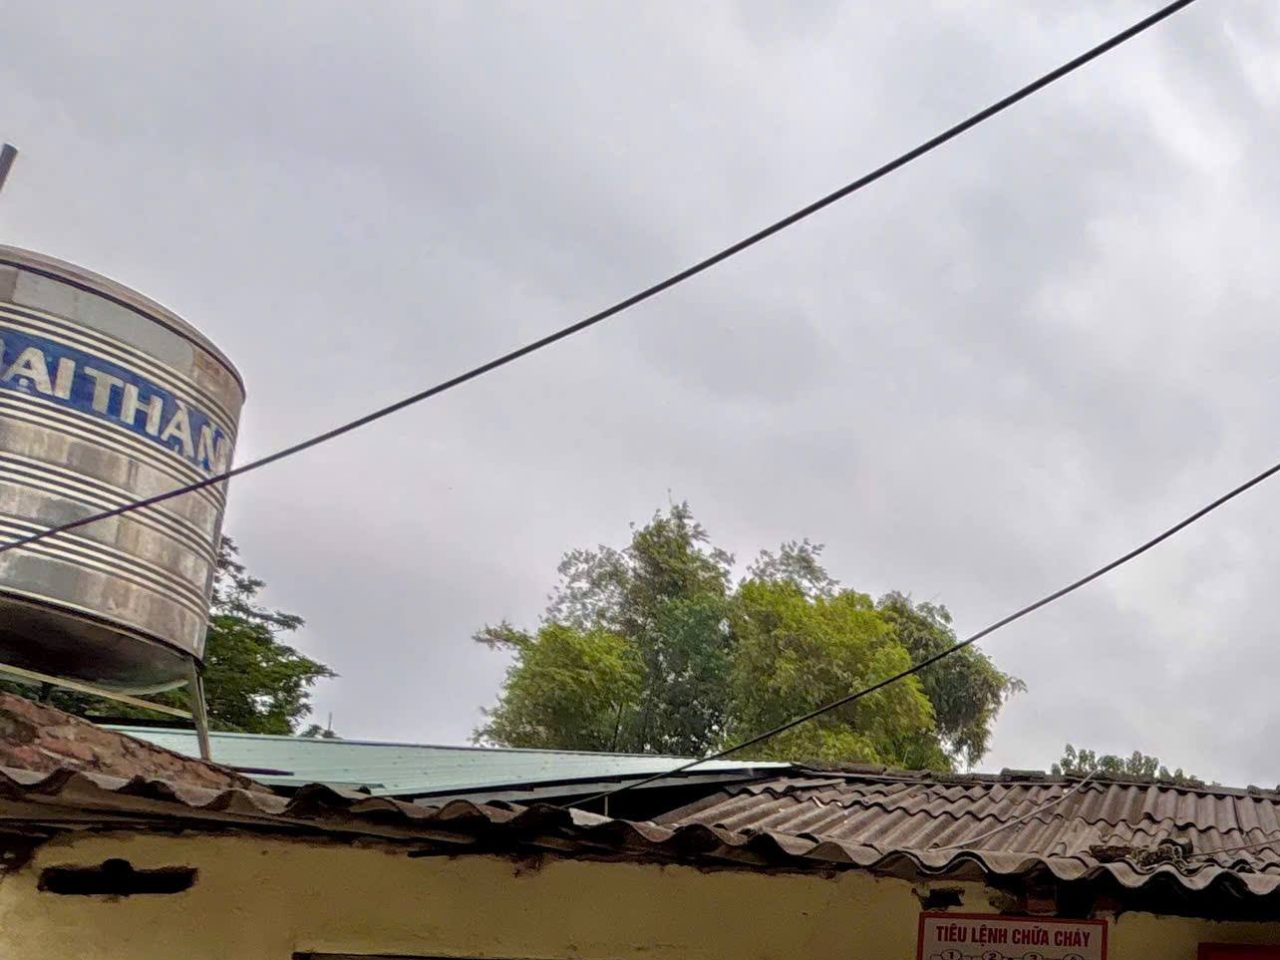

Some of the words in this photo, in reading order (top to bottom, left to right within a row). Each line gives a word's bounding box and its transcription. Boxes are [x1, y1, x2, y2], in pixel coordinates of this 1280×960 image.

[936, 923, 967, 942] TIÊU
[971, 924, 1008, 946] LỆNH
[1012, 926, 1049, 946] CHỮA
[1054, 929, 1090, 947] CHÁY
